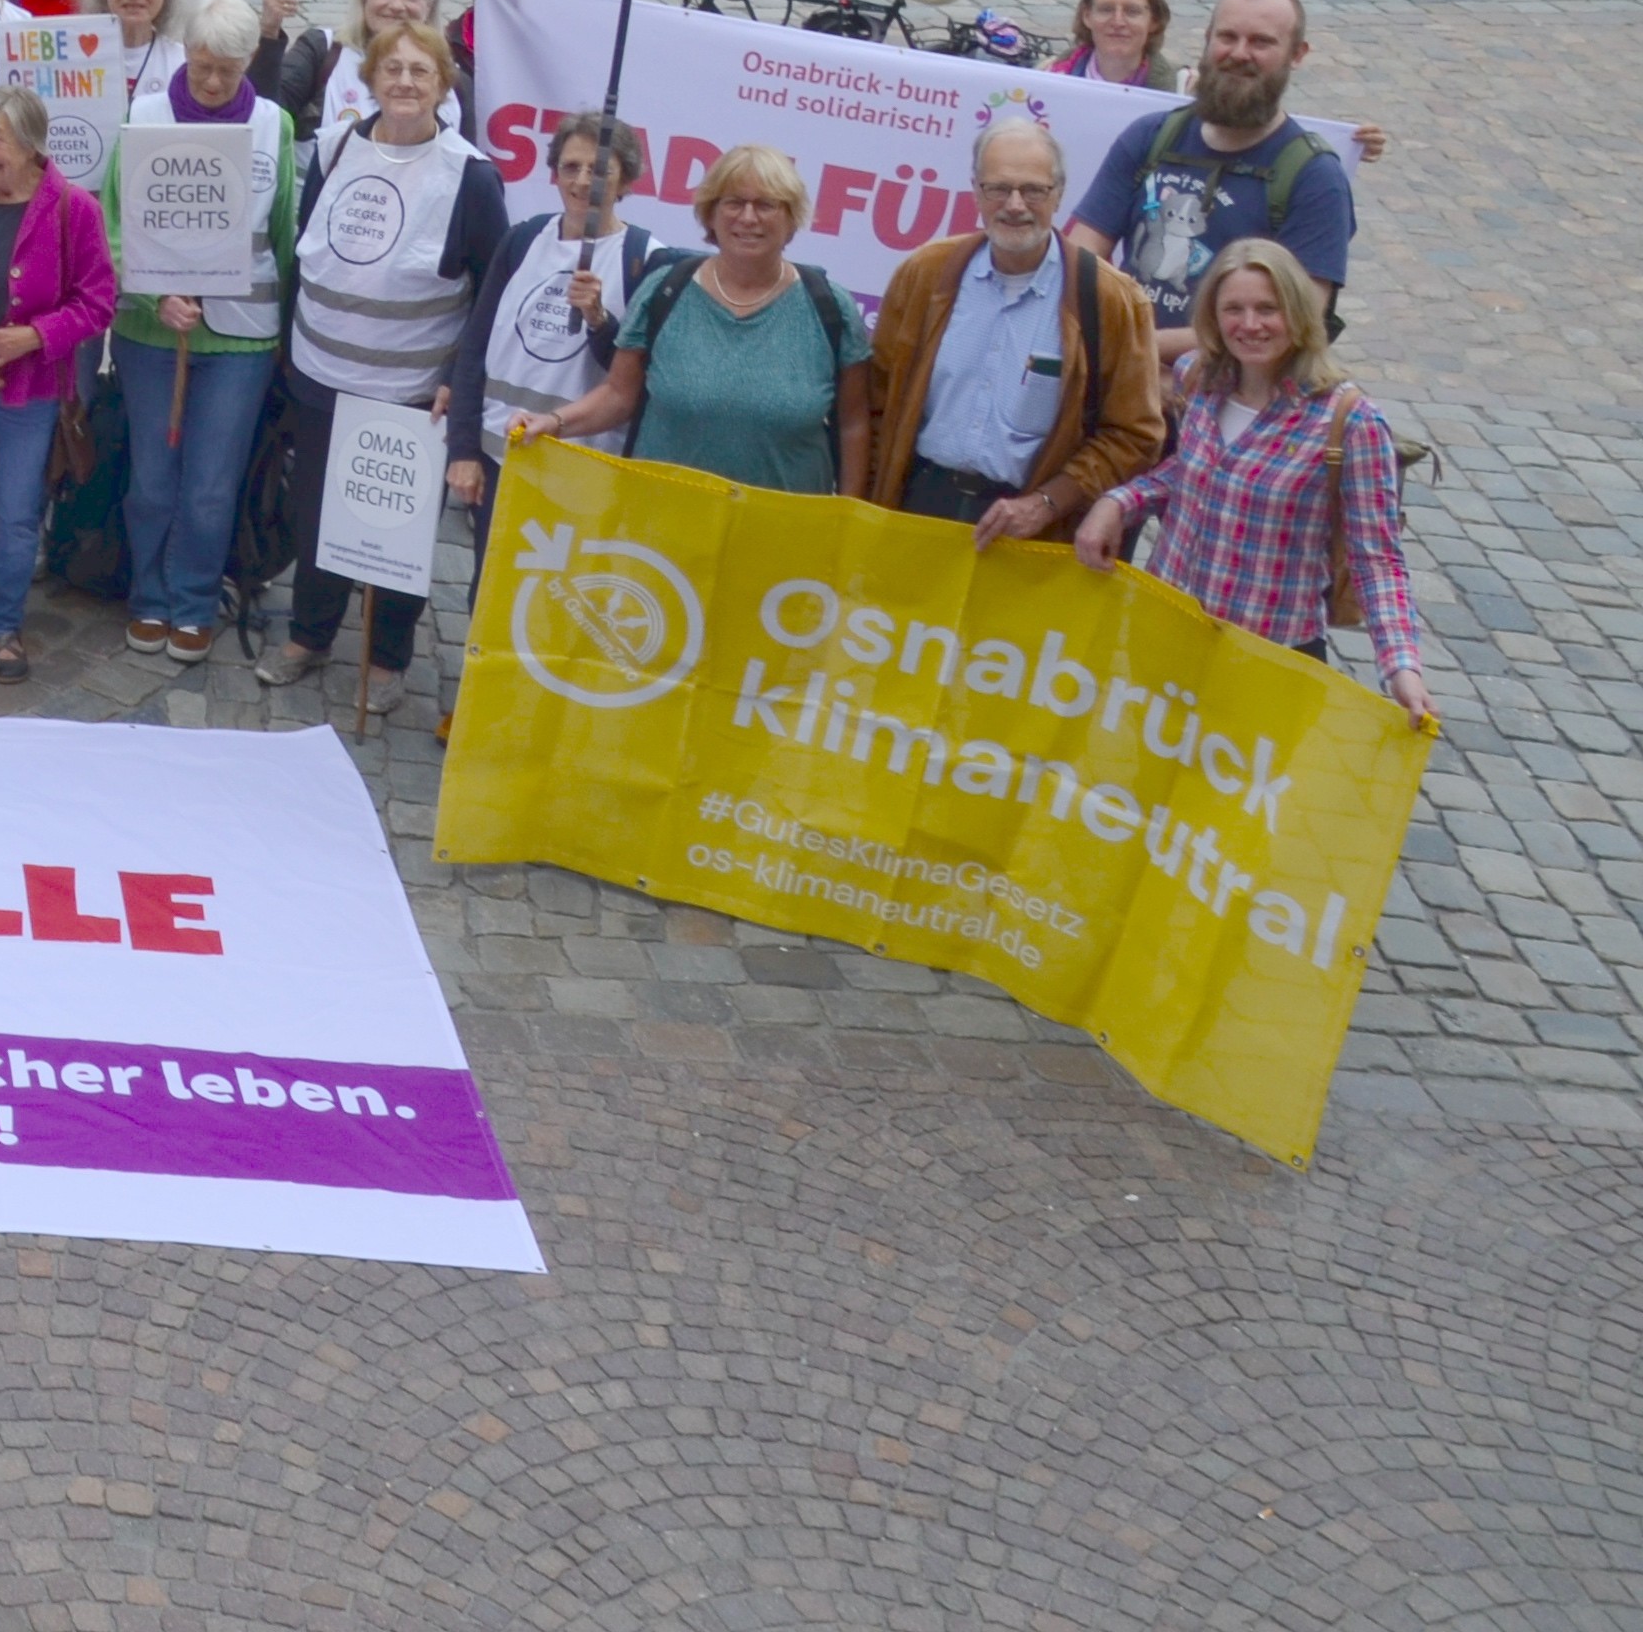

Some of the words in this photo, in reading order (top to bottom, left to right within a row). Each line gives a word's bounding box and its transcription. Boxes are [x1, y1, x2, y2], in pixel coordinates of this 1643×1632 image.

[5, 29, 68, 62] LIEBE
[742, 50, 960, 110] Osnabrück-bunt
[737, 83, 787, 110] und
[795, 92, 954, 139] solidarisch!
[48, 139, 89, 152] GEGEN
[49, 125, 86, 137] OMAS
[150, 157, 223, 177] OMAS
[146, 184, 225, 203] GEGEN
[353, 190, 387, 206] OMAS
[144, 210, 230, 230] RECHTS
[339, 223, 385, 240] RECHTS
[346, 207, 387, 223] GEGEN
[358, 430, 416, 461] OMAS
[351, 455, 416, 488] GEGEN
[344, 480, 416, 515] RECHTS
[565, 598, 638, 683] GermanZero
[760, 578, 1293, 834] Osnabrück
[732, 657, 1346, 968] klimaneutral
[698, 790, 1086, 940] #GutesKlimaGesetz
[686, 841, 1043, 968] os-klimaneutral.de
[164, 1059, 418, 1120] leben.
